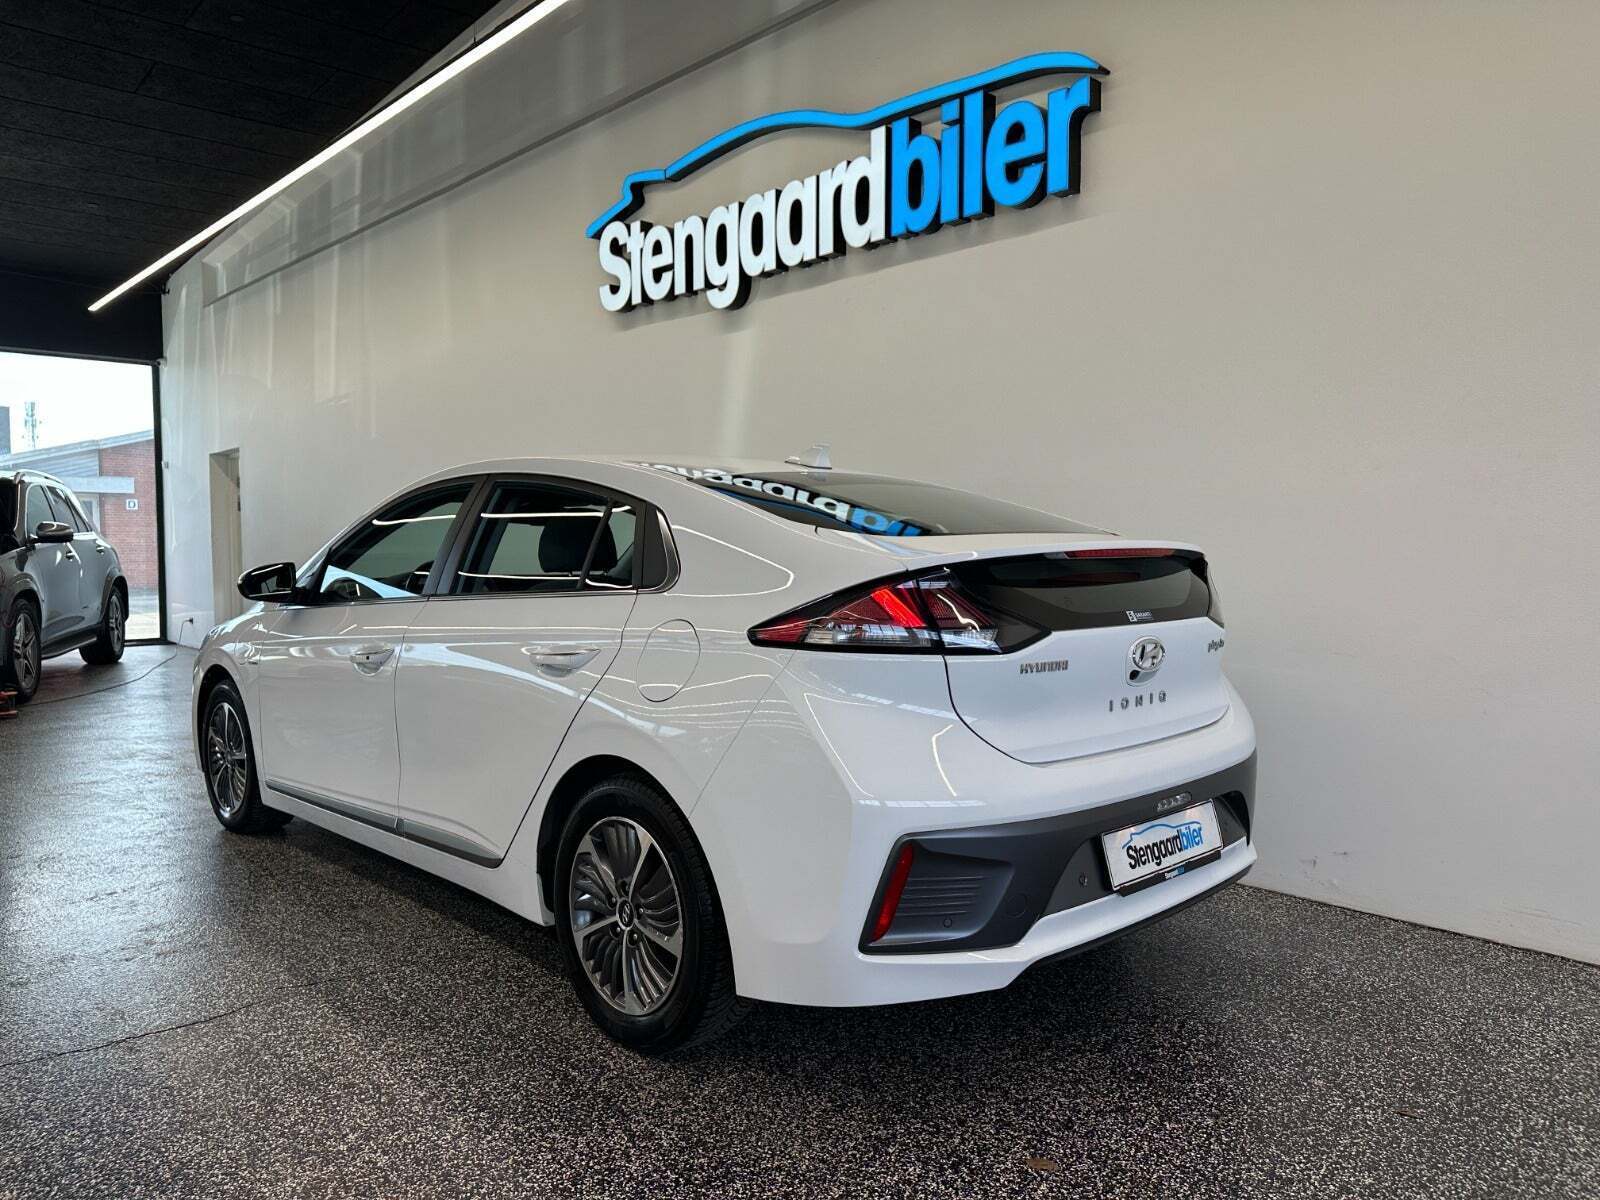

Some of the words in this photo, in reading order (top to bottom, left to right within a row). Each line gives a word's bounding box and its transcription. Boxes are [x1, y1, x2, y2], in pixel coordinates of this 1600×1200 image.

[599, 76, 1100, 313] Stengaardbiler
[1019, 659, 1069, 674] HYUNDAI
[1108, 690, 1167, 712] IONIQ
[1126, 825, 1203, 869] Stengaardbiler
